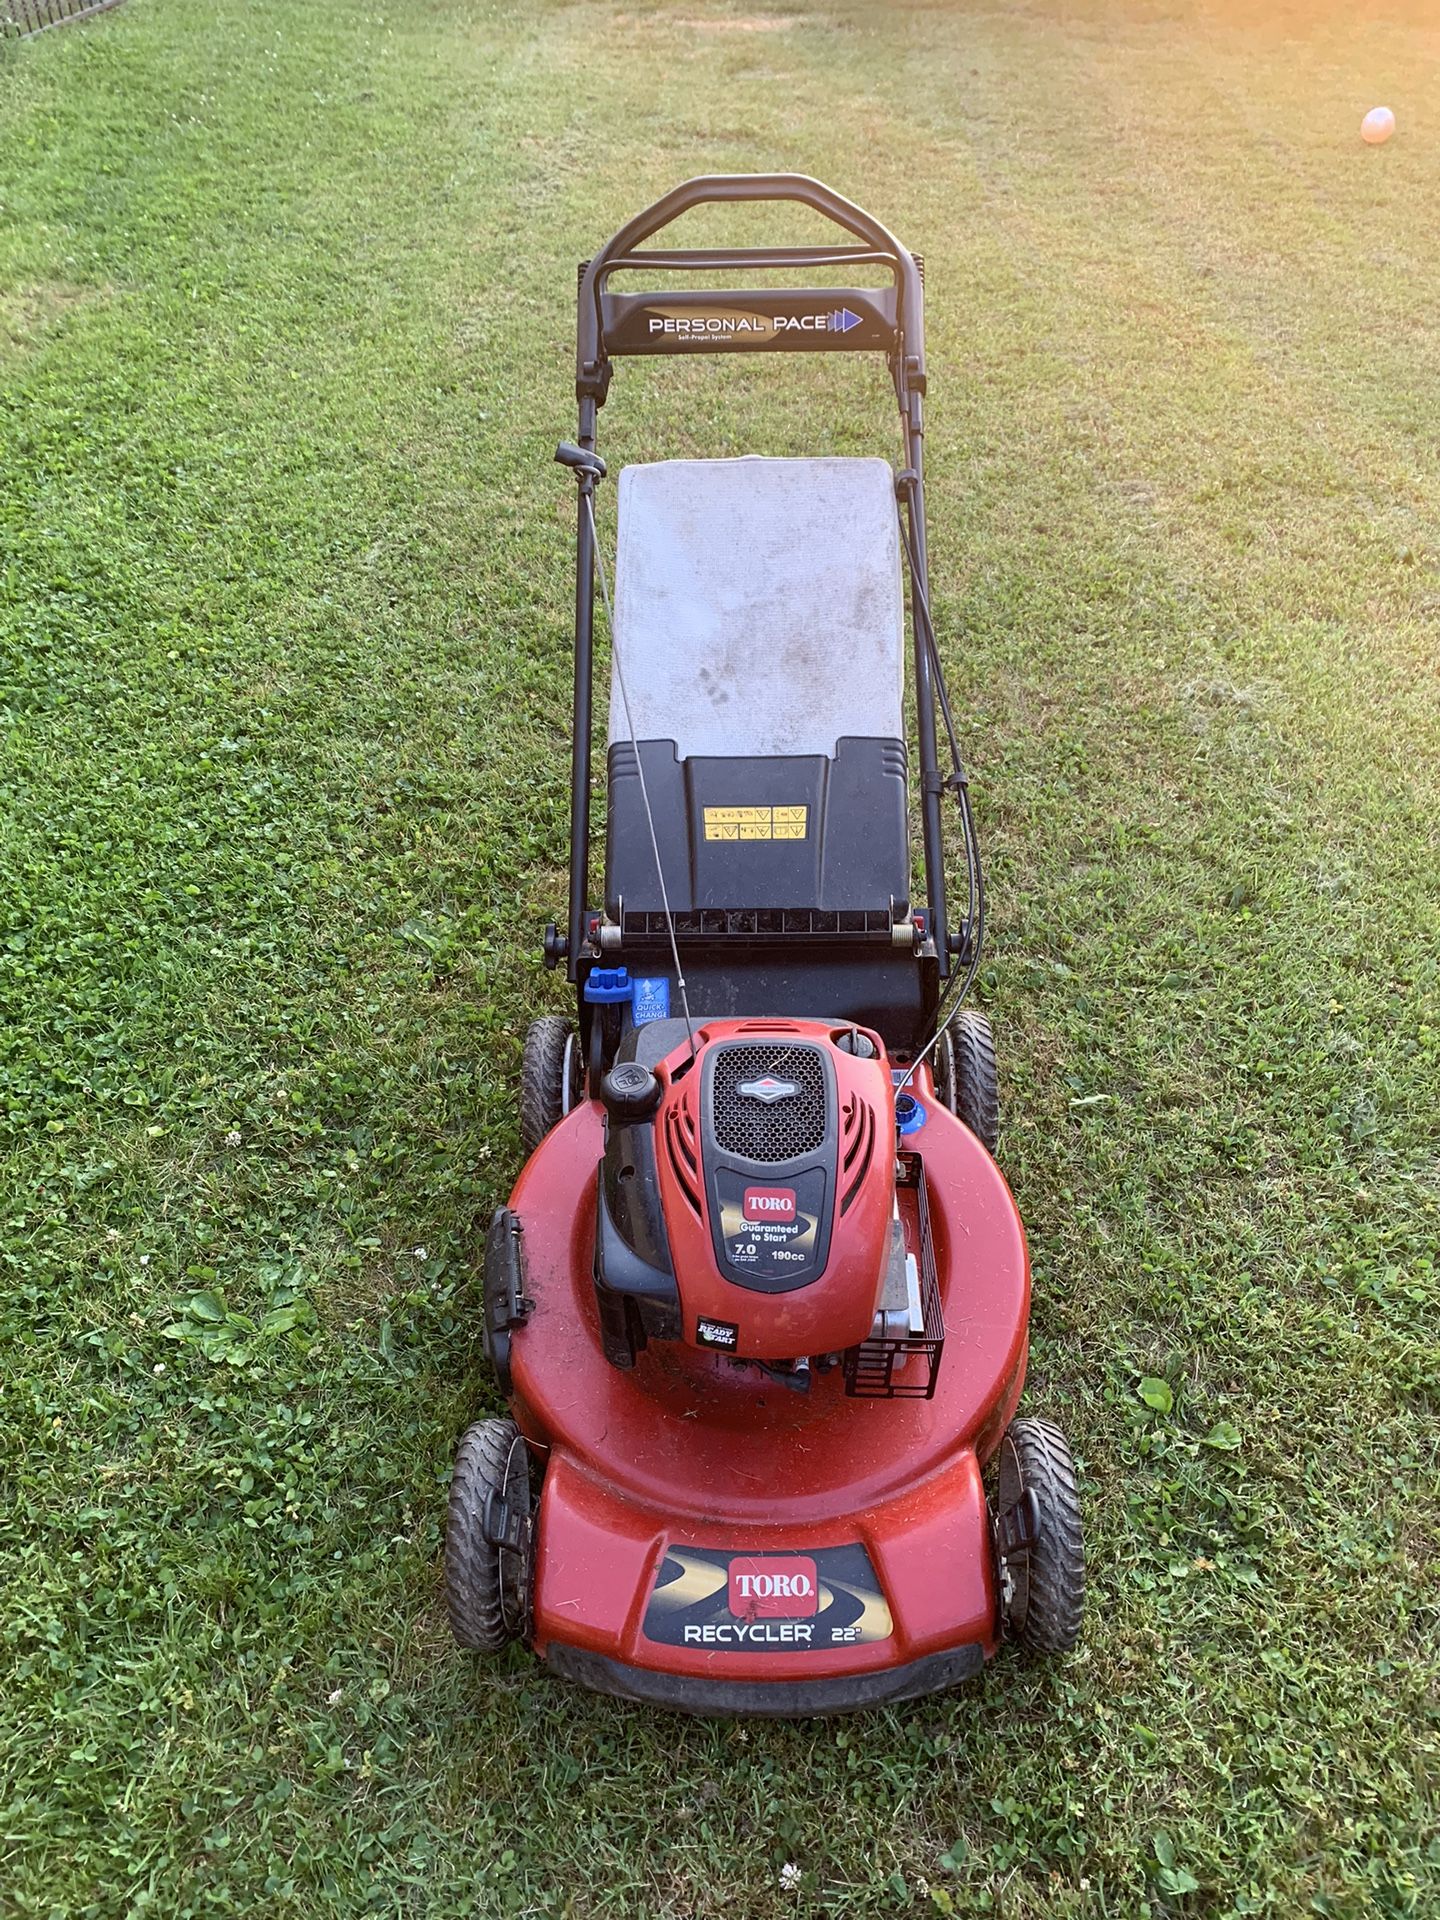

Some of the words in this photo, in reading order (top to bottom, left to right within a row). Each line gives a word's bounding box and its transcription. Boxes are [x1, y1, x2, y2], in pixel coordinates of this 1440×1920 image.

[649, 318, 765, 333] PERSONAL
[773, 315, 827, 331] PACE
[635, 1011, 667, 1019] CHANGE
[748, 1196, 793, 1211] TORO
[740, 1223, 799, 1233] Guaranteed
[751, 1233, 762, 1242] to
[763, 1233, 787, 1243] Start
[735, 1244, 757, 1255] 7.0
[771, 1250, 805, 1261] 190cc
[698, 1325, 733, 1337] READY
[736, 1574, 815, 1598] TORO
[684, 1624, 815, 1642] RECYCLER
[831, 1627, 862, 1642] 22"
